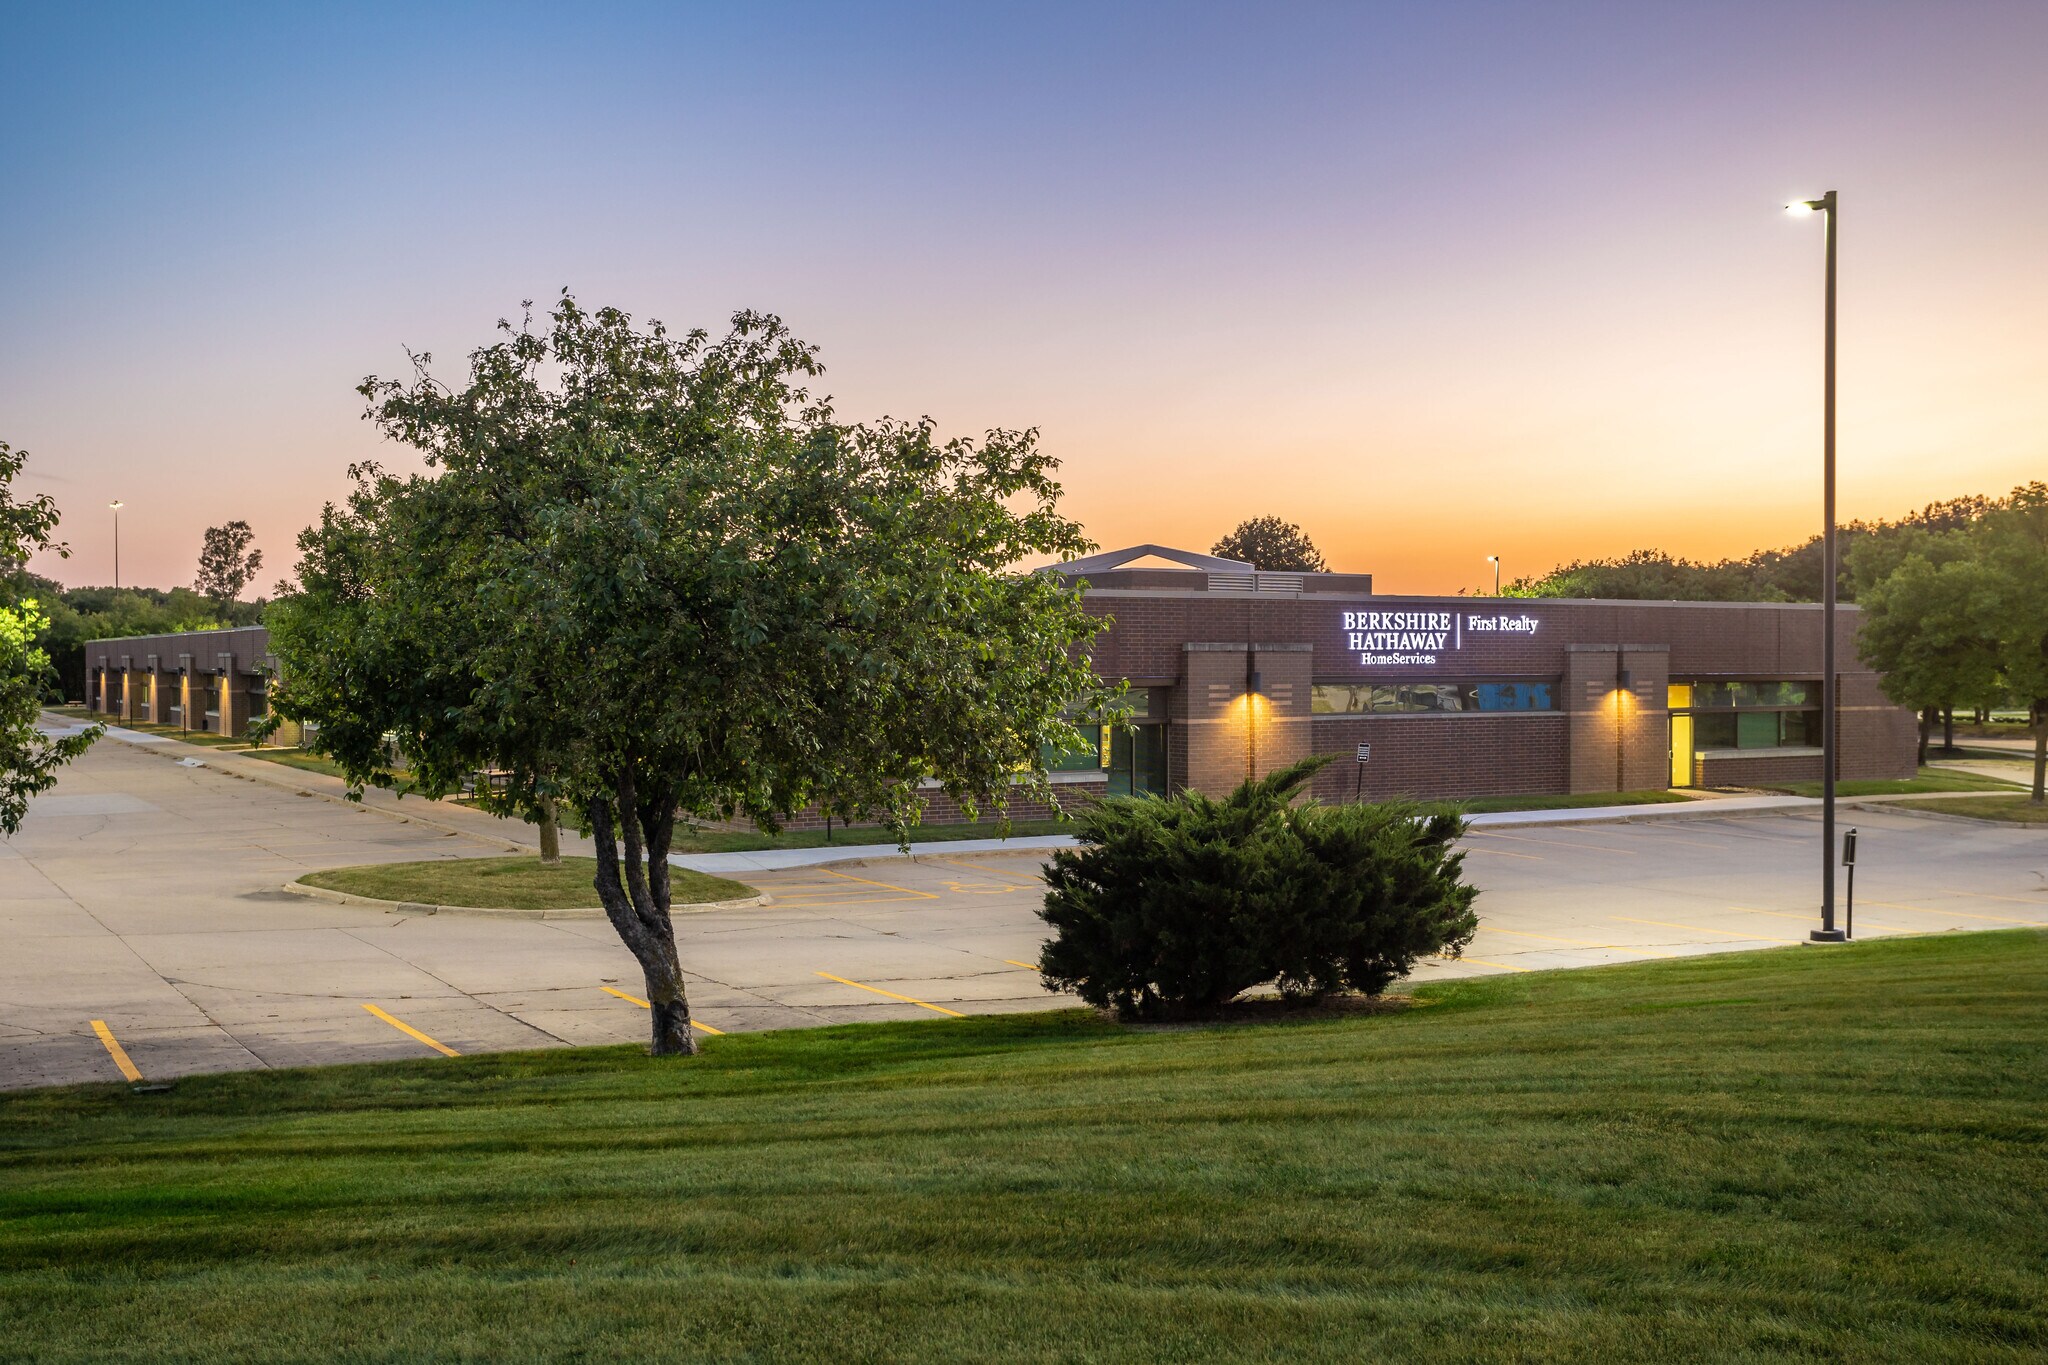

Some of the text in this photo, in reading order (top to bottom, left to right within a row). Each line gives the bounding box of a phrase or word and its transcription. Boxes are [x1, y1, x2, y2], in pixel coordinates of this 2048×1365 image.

[1343, 612, 1450, 631] BERKSHIRE
[1468, 615, 1538, 635] First Realty
[1349, 632, 1447, 650] HATHAWAY
[1361, 652, 1436, 665] HomeServices
